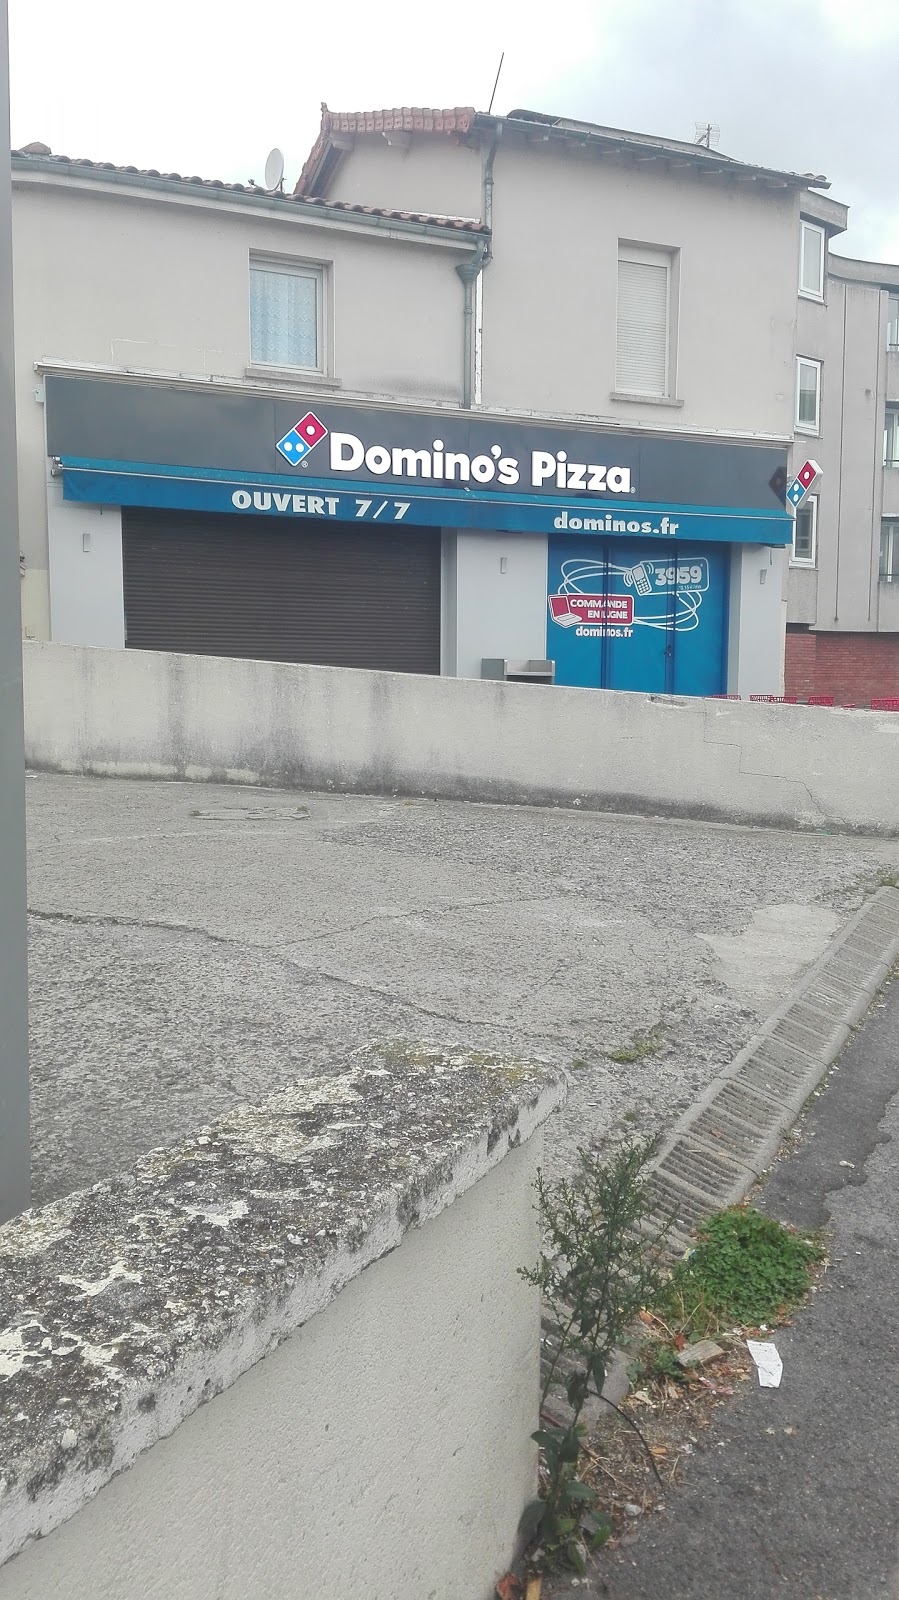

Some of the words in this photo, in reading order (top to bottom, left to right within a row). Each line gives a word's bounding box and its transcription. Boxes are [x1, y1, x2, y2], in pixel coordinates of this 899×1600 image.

[329, 431, 520, 485] Domino's
[531, 450, 632, 494] Pizza
[231, 490, 340, 516] OUVERT
[553, 511, 679, 535] dominos.fr
[655, 565, 702, 586] 3959
[570, 599, 628, 609] COMMANDE
[587, 610, 600, 619] EN
[575, 626, 633, 638] dominos.fr
